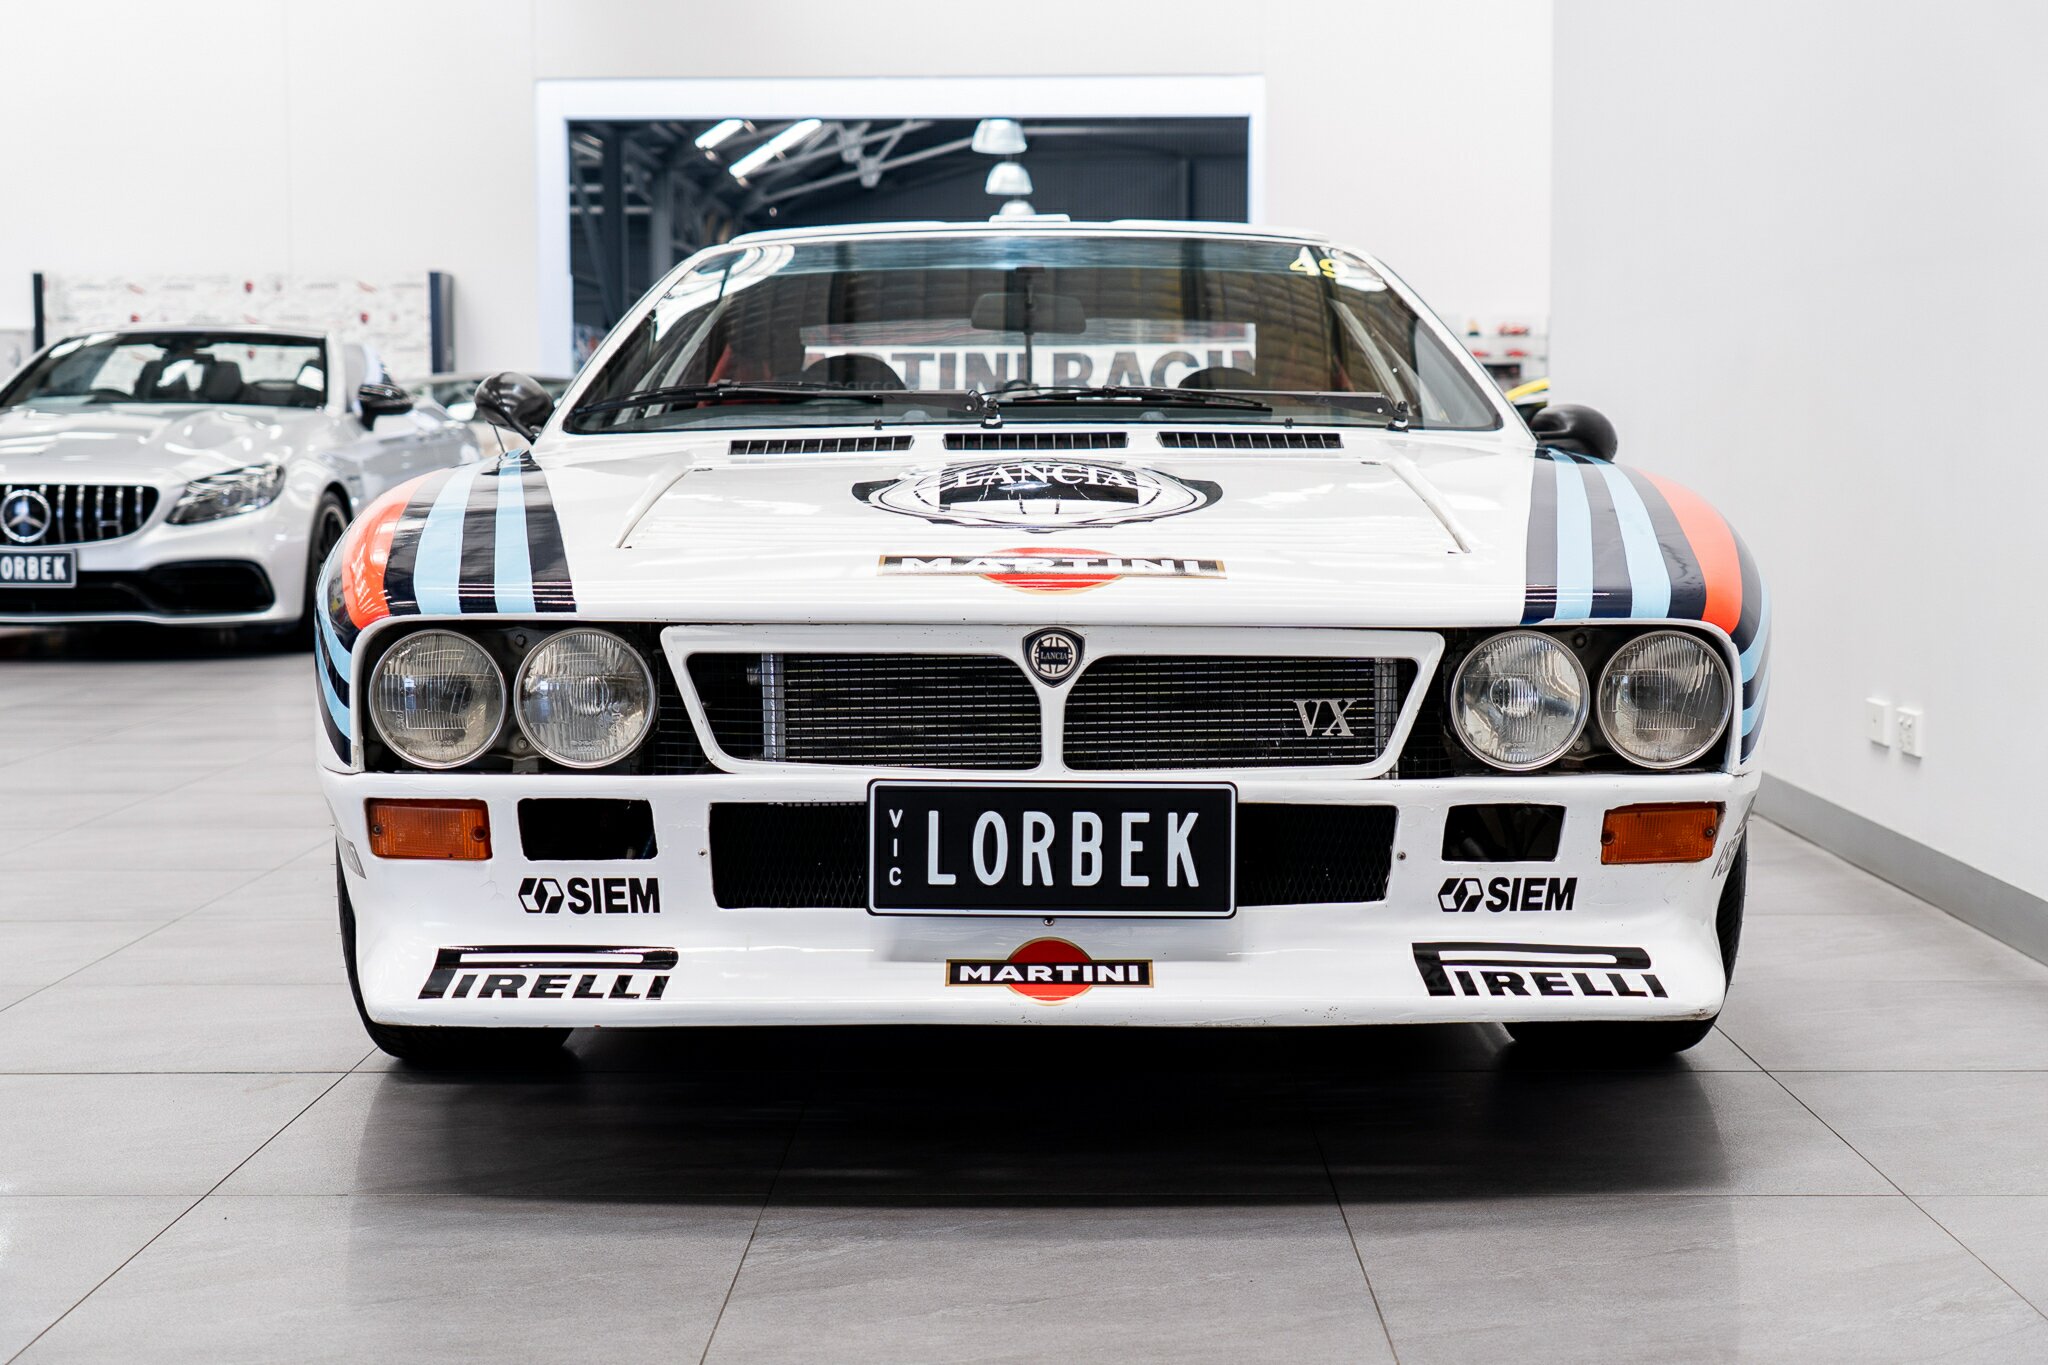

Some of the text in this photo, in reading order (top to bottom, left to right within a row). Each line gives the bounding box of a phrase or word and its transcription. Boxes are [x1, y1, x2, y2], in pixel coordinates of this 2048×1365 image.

[954, 464, 1139, 488] LANCIA
[900, 556, 1204, 575] MARTINI
[1040, 651, 1069, 660] LANCIA
[1292, 699, 1358, 737] VX
[888, 808, 904, 886] VIC
[927, 810, 1200, 888] LORBEK
[567, 877, 661, 915] SIEM
[1485, 876, 1578, 912] SIEM
[417, 945, 679, 1001] PIRELLI
[959, 964, 1140, 983] MARTINI
[1411, 941, 1669, 998] PIRELLI
